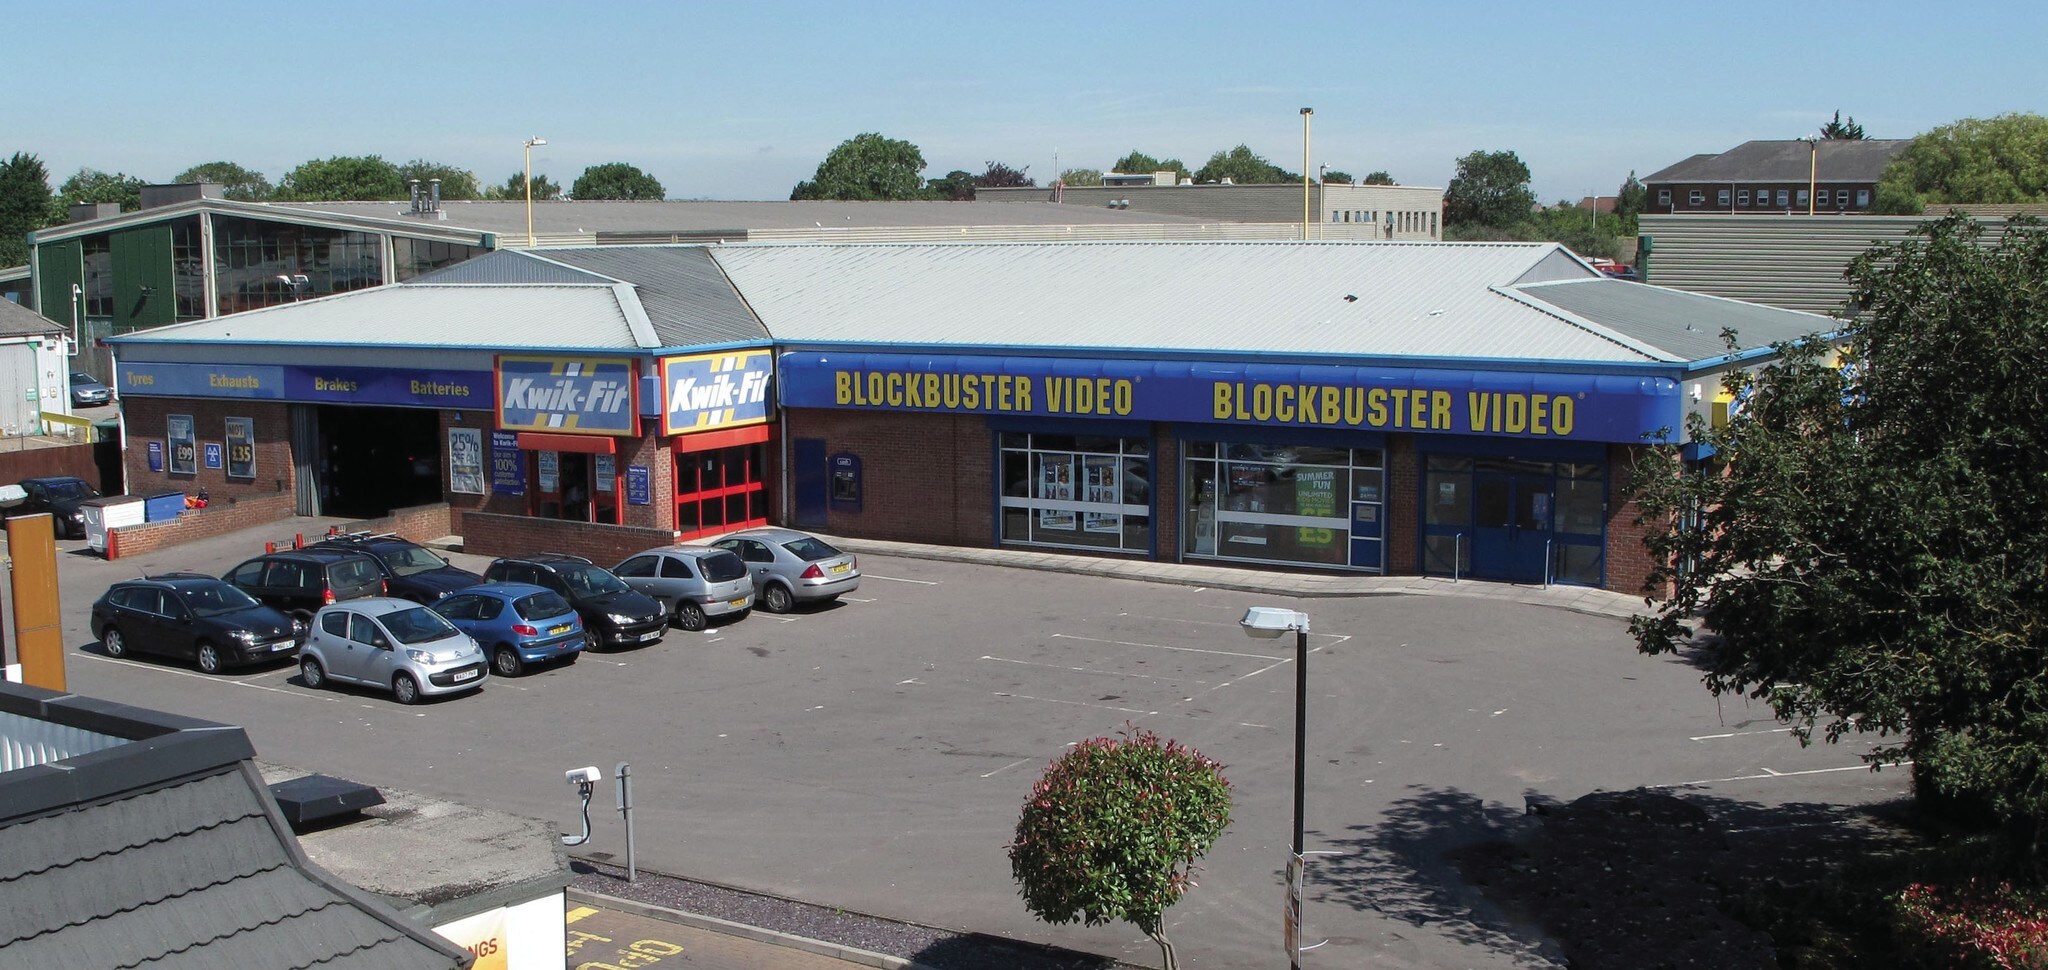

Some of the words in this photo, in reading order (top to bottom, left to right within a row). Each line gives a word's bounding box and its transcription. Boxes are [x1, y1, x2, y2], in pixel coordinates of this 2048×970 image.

[127, 372, 153, 386] Tyres
[210, 374, 259, 388] Exhausts
[315, 377, 357, 392] Brakes
[410, 380, 469, 397] Batteries
[504, 377, 628, 413] Kwik-Fit
[835, 371, 1032, 412] BLOCKBUSTER
[1045, 376, 1133, 416] VIDEO
[1213, 381, 1451, 431] BLOCKBUSTER
[1468, 391, 1574, 436] VIDEO
[452, 433, 479, 453] 25%
[232, 446, 251, 462] £35
[495, 459, 517, 471] 100%
[1296, 472, 1334, 481] SUMMER
[1313, 481, 1330, 490] FUN
[1298, 491, 1332, 499] UNLIMITED
